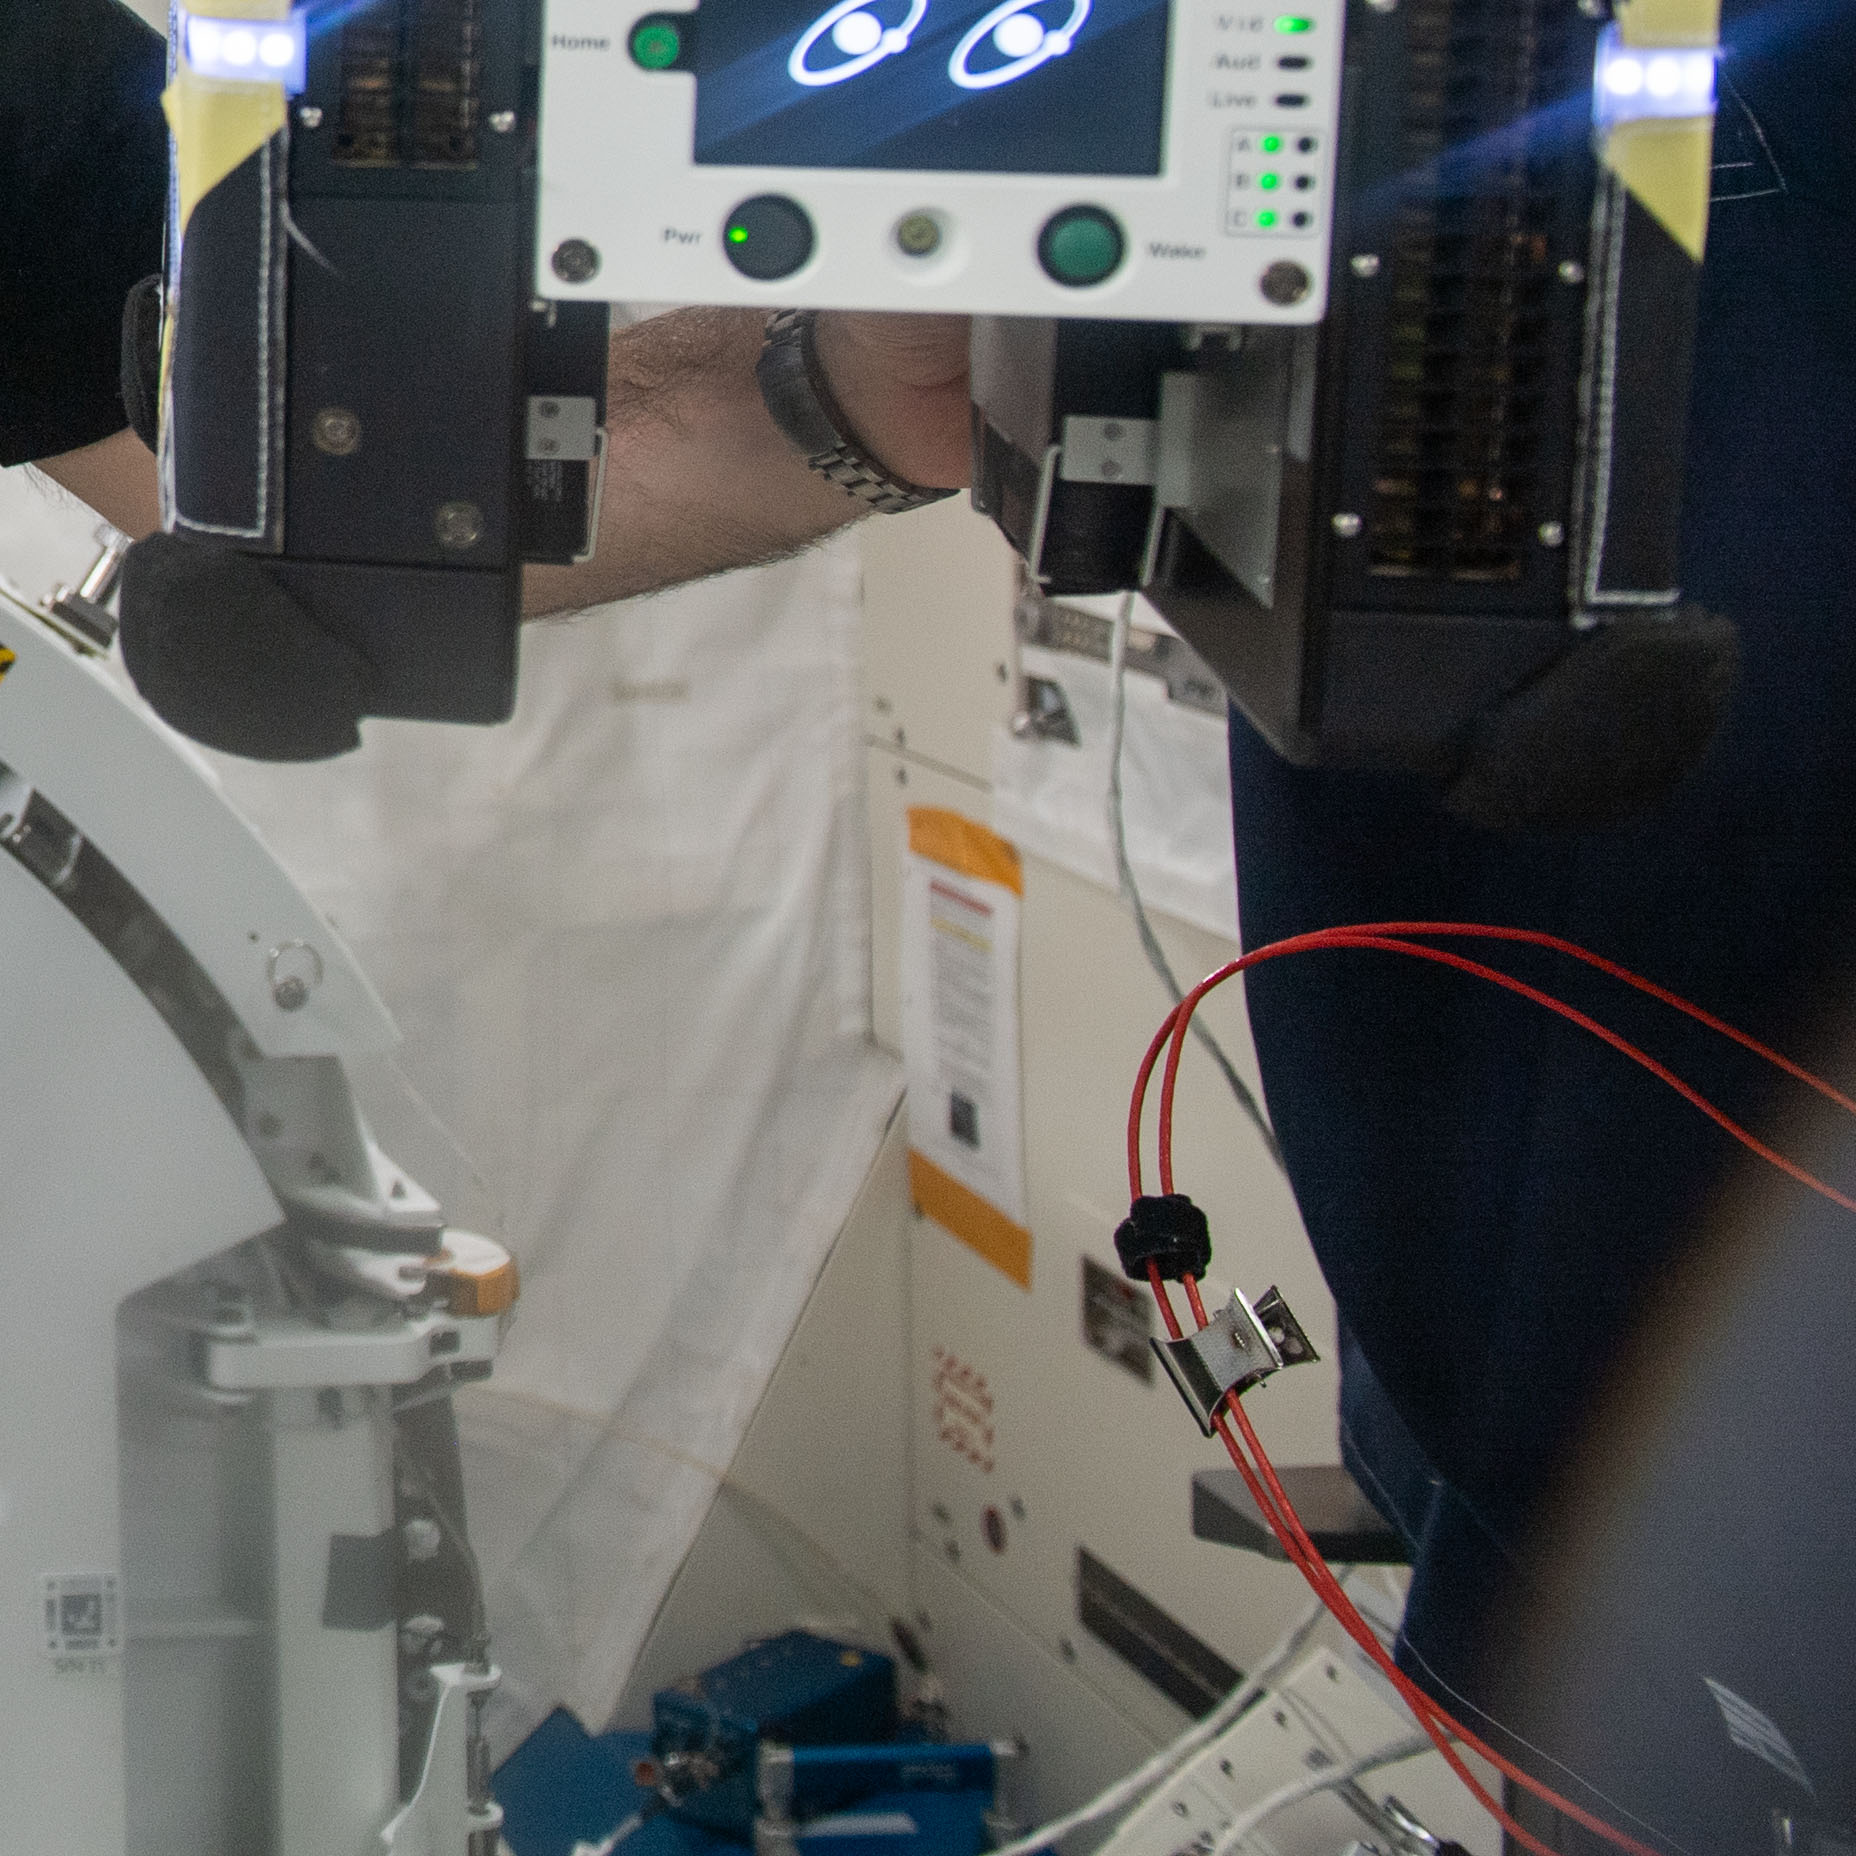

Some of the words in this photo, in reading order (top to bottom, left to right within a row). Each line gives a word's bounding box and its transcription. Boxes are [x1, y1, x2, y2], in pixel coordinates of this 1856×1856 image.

[550, 33, 611, 53] Home
[1214, 53, 1261, 71] Aud
[661, 227, 702, 247] Pwr
[1146, 241, 1207, 261] Wake
